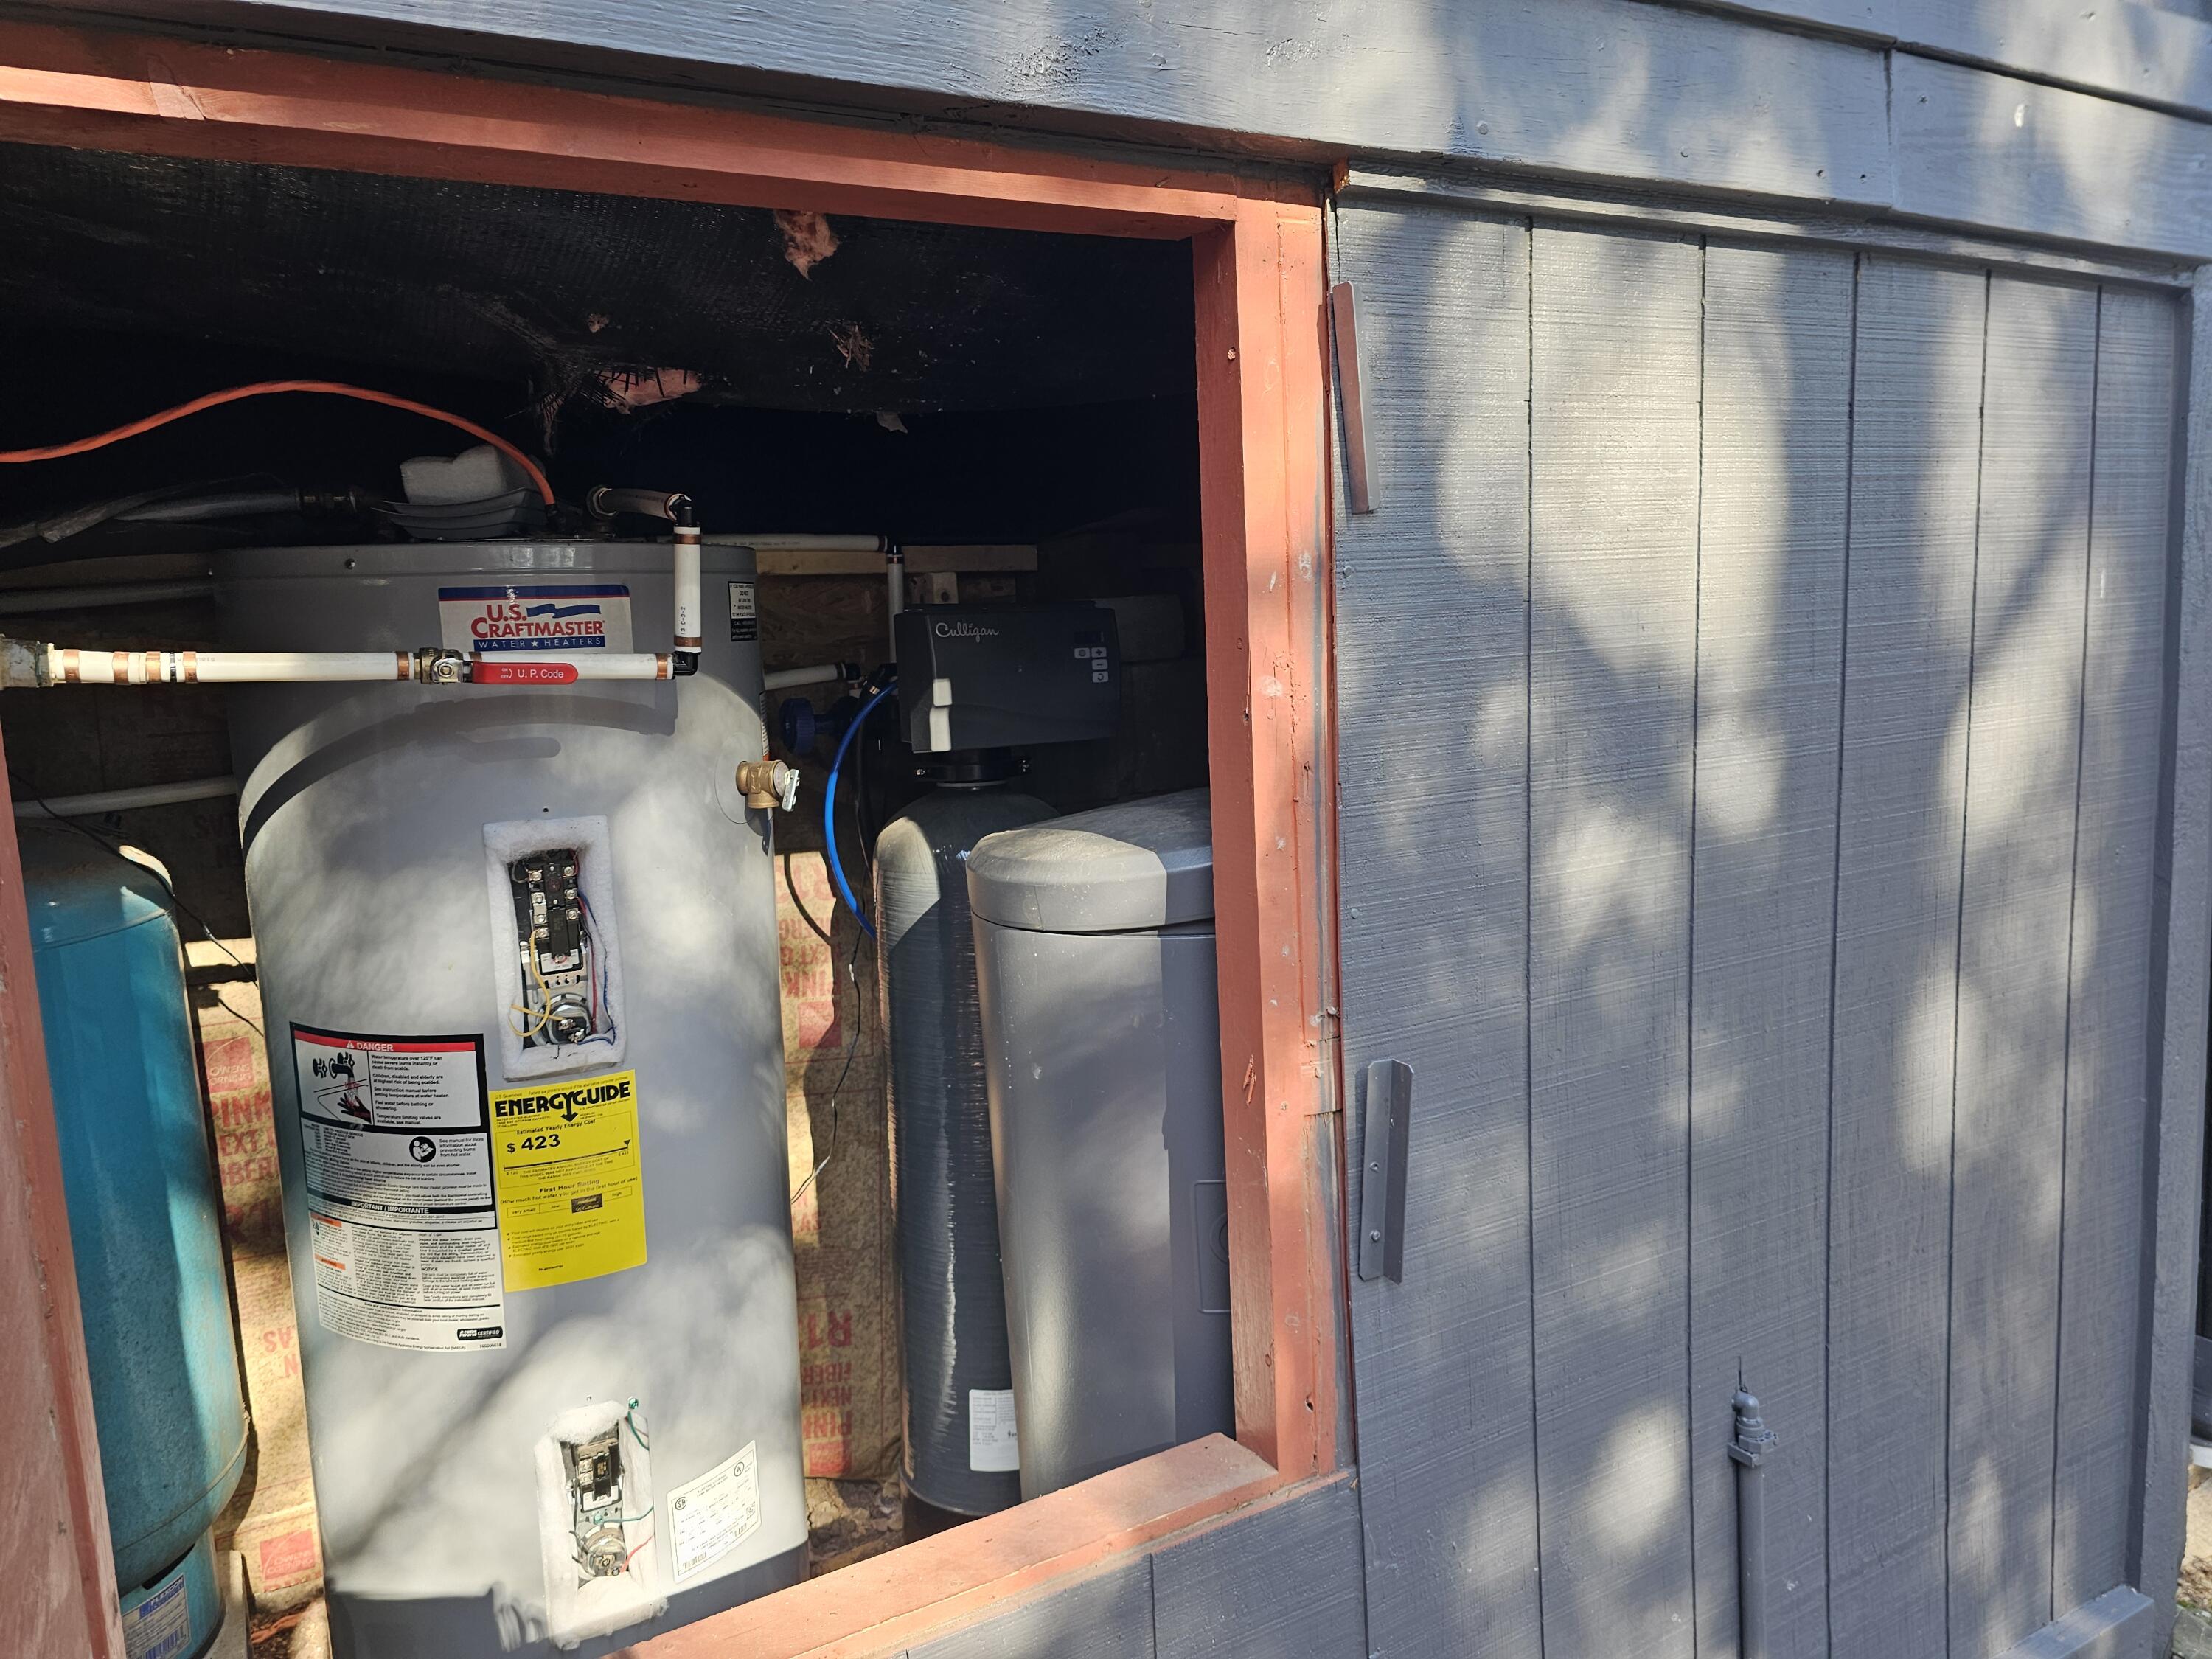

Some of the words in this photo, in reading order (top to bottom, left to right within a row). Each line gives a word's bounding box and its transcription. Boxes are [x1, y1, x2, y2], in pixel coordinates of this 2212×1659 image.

[486, 603, 527, 622] U.S.
[470, 617, 605, 639] CRAFTMASTER
[935, 621, 999, 643] Culligan
[479, 640, 526, 649] WATER
[544, 637, 601, 647] HEATERS
[518, 669, 527, 678] U.
[530, 669, 538, 678] P.
[540, 669, 564, 678] Code
[356, 1042, 394, 1051] DANGER
[210, 1063, 251, 1077] OWENS
[495, 1081, 631, 1119] ENERGYGUIDE
[517, 1126, 543, 1135] Estimated
[564, 1121, 582, 1129] Energy
[507, 1143, 516, 1154] $
[521, 1134, 560, 1150] 423
[351, 1201, 383, 1211] IMPORTANT
